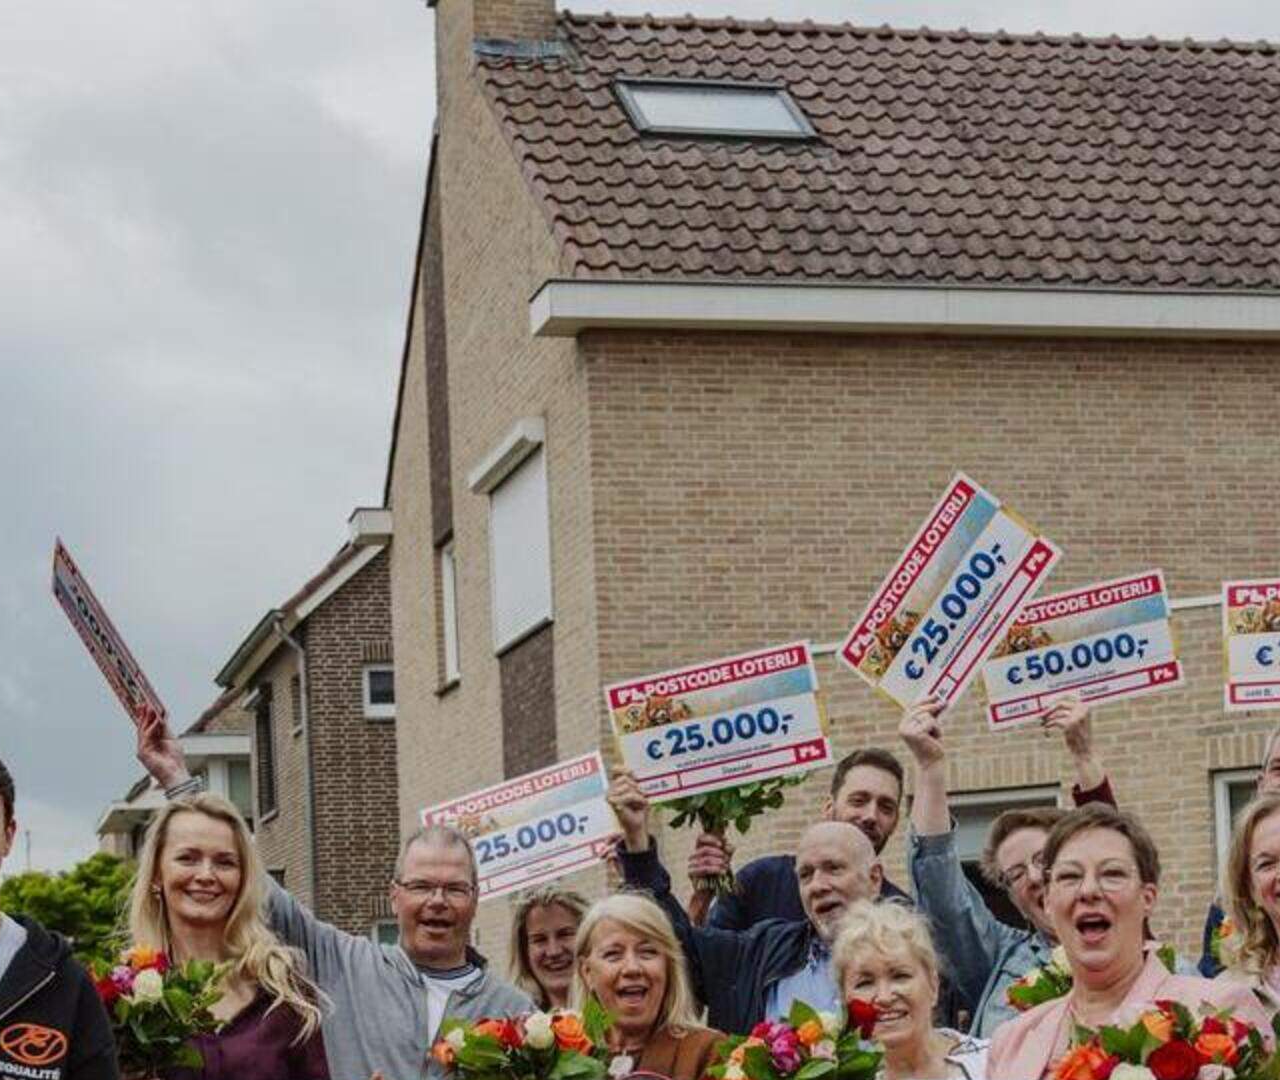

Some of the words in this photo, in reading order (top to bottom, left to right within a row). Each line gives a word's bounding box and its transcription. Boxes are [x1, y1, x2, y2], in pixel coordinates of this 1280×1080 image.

[867, 549, 926, 634] POSTCODE
[922, 487, 969, 553] LOTERIJ
[1017, 597, 1089, 624] OSTCODE
[1092, 579, 1153, 603] LOTERIJ
[644, 667, 732, 700] POSTCODE
[734, 650, 799, 677] LOTERIJ
[1025, 633, 1149, 681] 50.000,-
[665, 707, 794, 757] 25.000,-
[454, 778, 534, 817] POSTCODE
[534, 760, 592, 791] LOTERIJ
